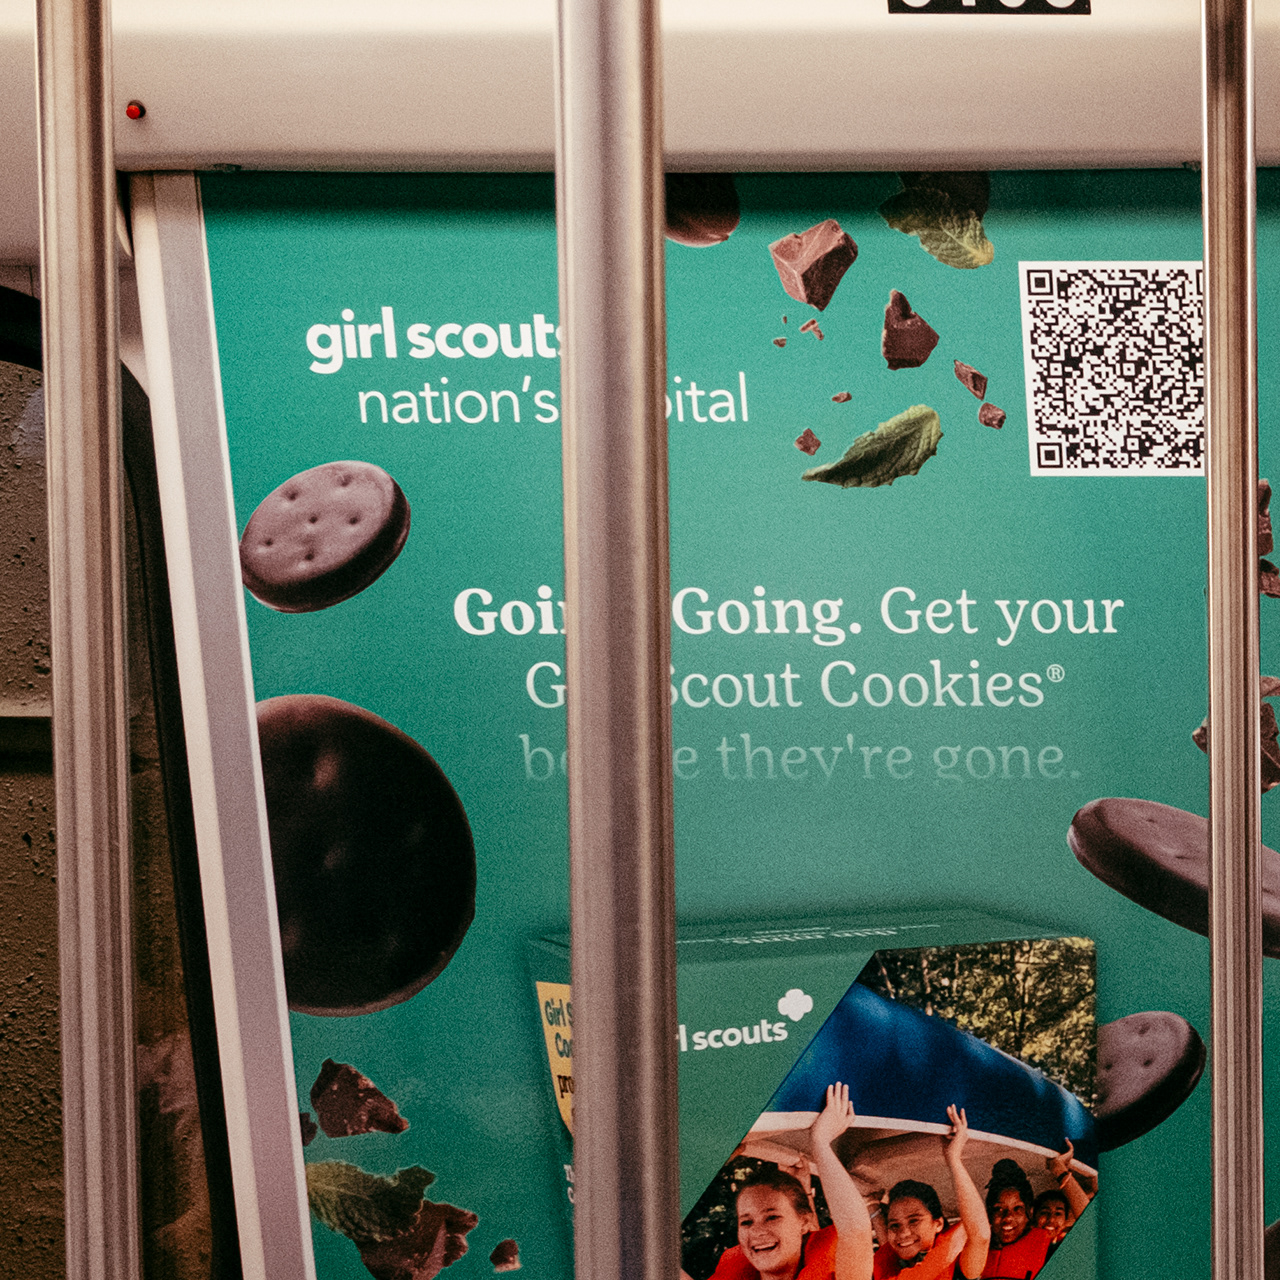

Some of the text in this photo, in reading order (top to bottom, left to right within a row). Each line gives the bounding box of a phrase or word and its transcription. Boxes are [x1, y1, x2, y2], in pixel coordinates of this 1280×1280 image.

[305, 306, 397, 374] girl
[358, 372, 749, 424] nation's ital
[672, 585, 862, 646] Going.
[880, 586, 978, 634] Get
[994, 599, 1125, 646] your
[716, 733, 915, 780] they're
[932, 745, 1081, 784] gone.
[692, 1019, 788, 1051] scouts
